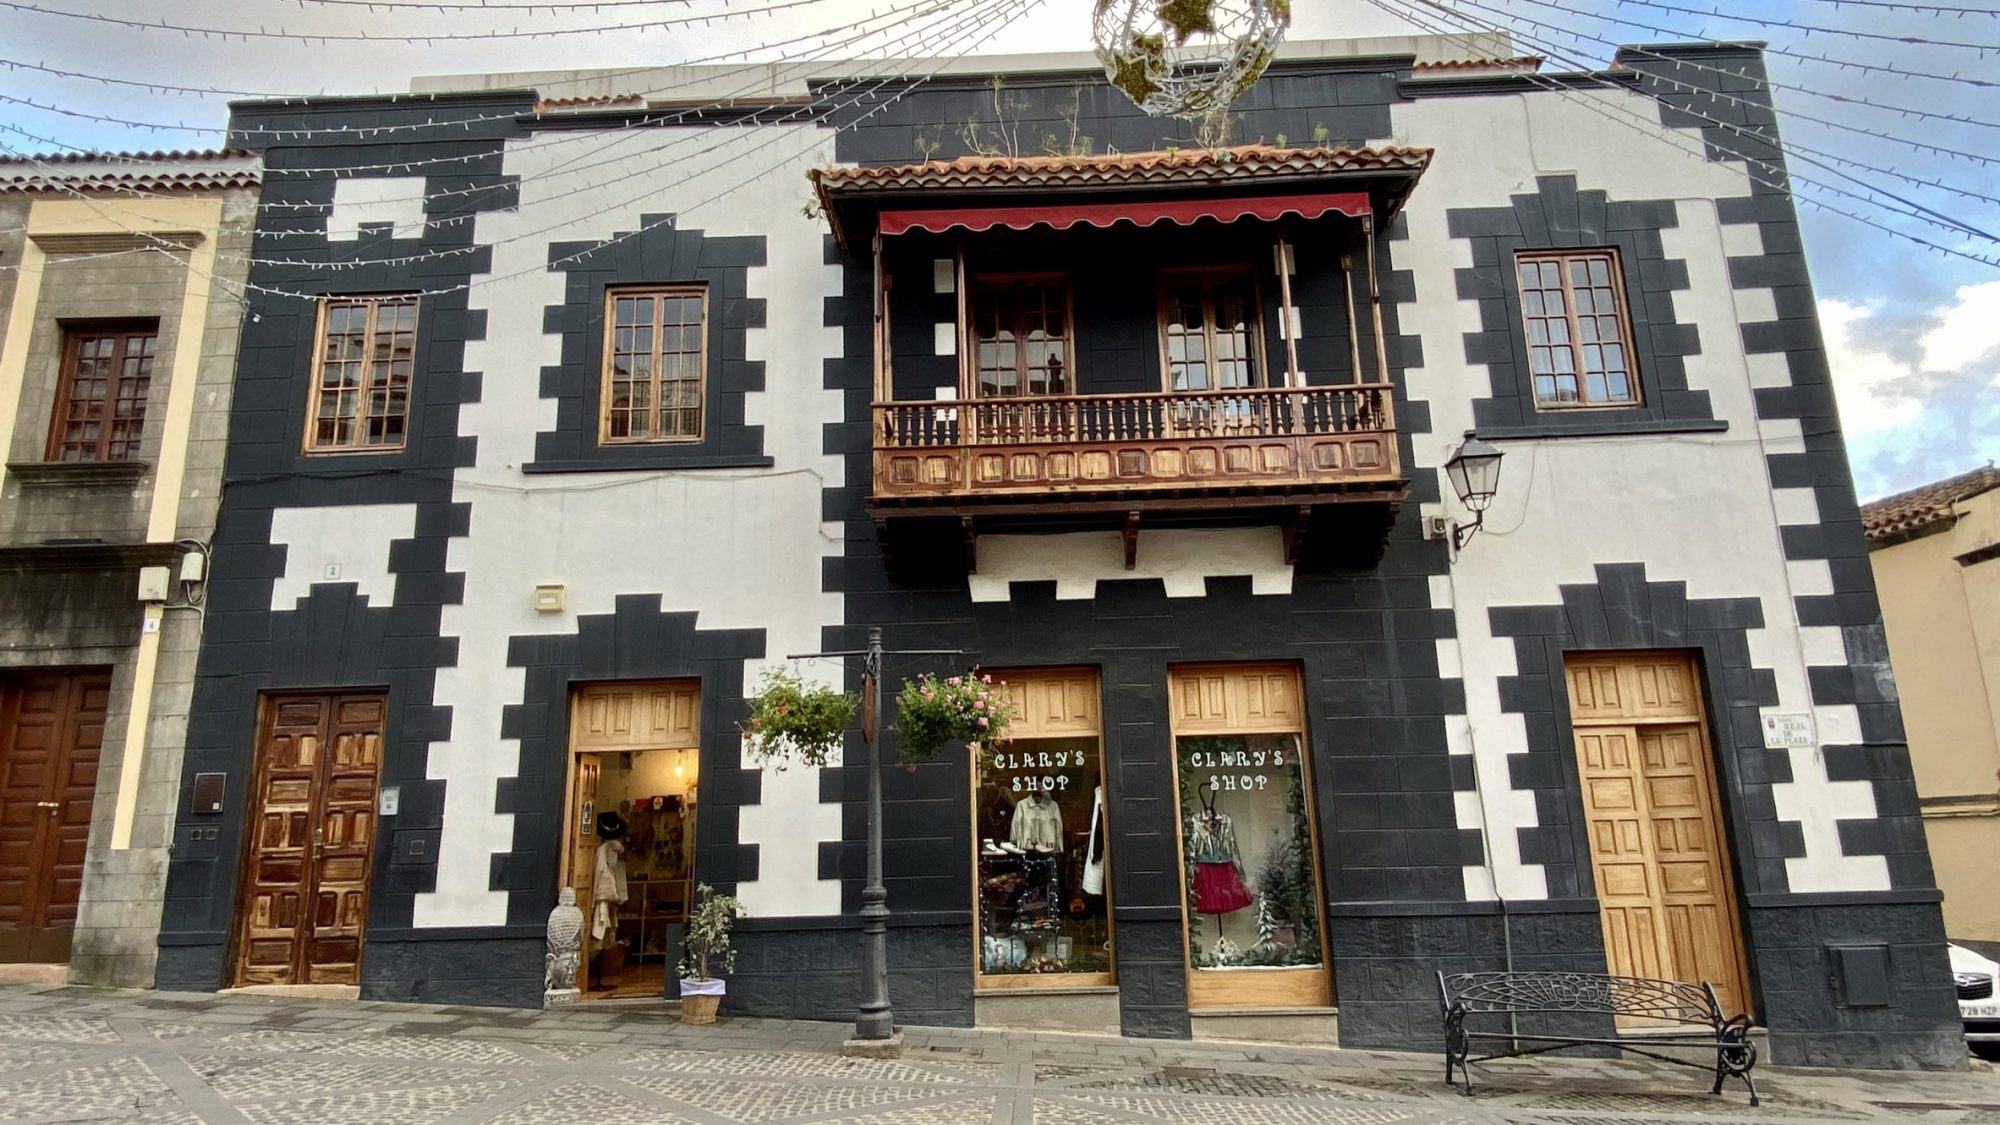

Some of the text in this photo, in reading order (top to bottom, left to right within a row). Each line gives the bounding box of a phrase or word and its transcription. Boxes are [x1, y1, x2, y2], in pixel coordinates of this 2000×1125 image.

[1784, 722, 1806, 730] REAL
[1770, 737, 1808, 745] LA PLAZA
[995, 749, 1085, 769] CLARY'S
[1191, 749, 1284, 768] CLARY'S
[1012, 775, 1069, 792] SHOP
[1210, 775, 1268, 791] SHOP
